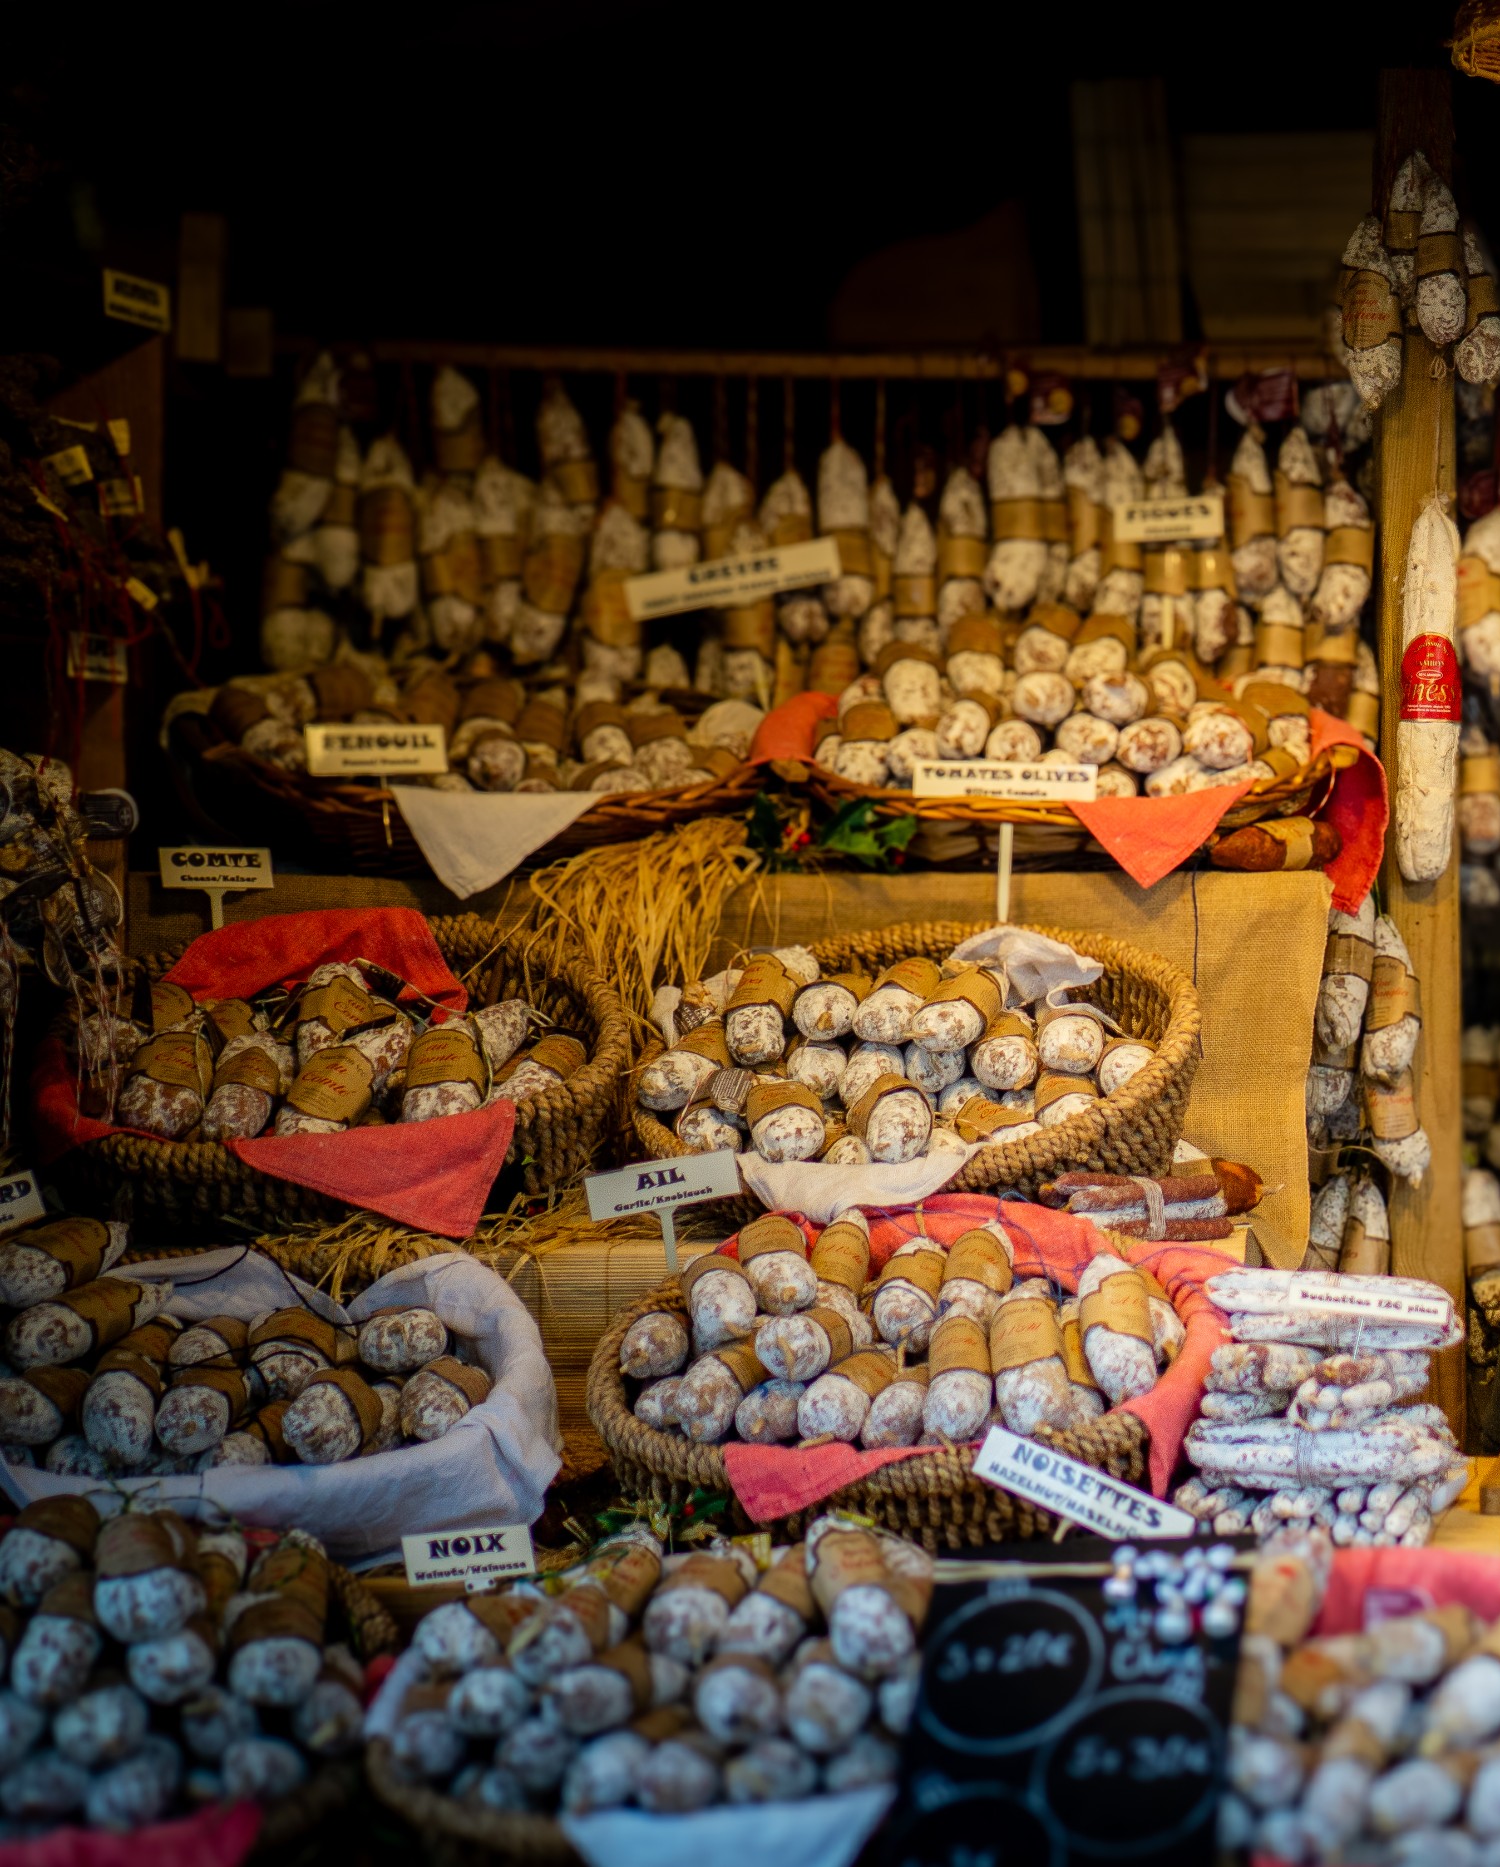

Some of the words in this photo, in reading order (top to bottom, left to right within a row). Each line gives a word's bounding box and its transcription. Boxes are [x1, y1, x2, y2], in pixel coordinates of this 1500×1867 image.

[323, 733, 436, 752] FENOUIL
[922, 767, 1013, 781] TOMATES
[1021, 769, 1090, 783] OLIVES
[171, 851, 261, 868] COMTE
[635, 1166, 687, 1192] AIL
[613, 1185, 714, 1213] Garlic/Knoblauch
[1011, 1442, 1163, 1529] NOISETTES
[427, 1532, 506, 1560] NOIX
